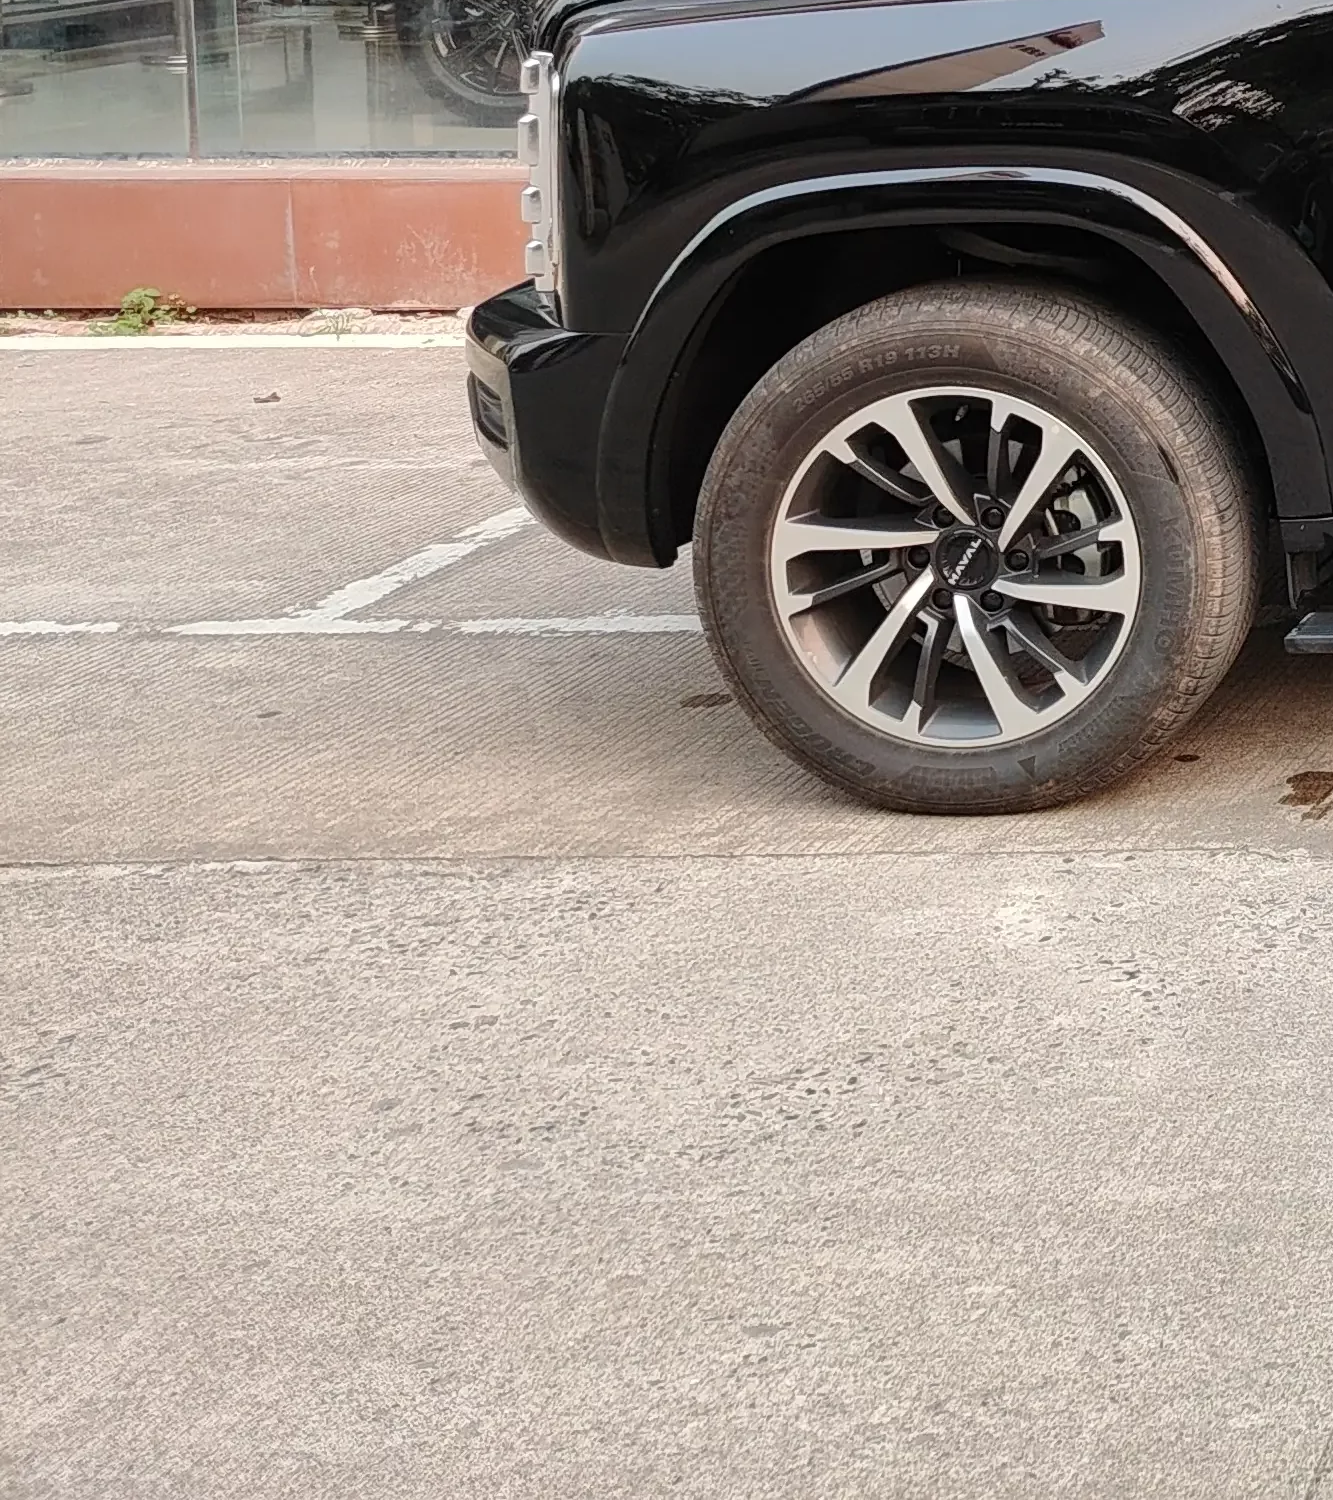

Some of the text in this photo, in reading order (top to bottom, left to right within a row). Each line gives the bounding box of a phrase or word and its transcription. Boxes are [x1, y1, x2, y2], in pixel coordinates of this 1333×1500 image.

[857, 350, 898, 375] R19
[904, 344, 960, 362] 113H
[947, 538, 982, 586] HAVAL
[1153, 515, 1195, 656] KUMHO
